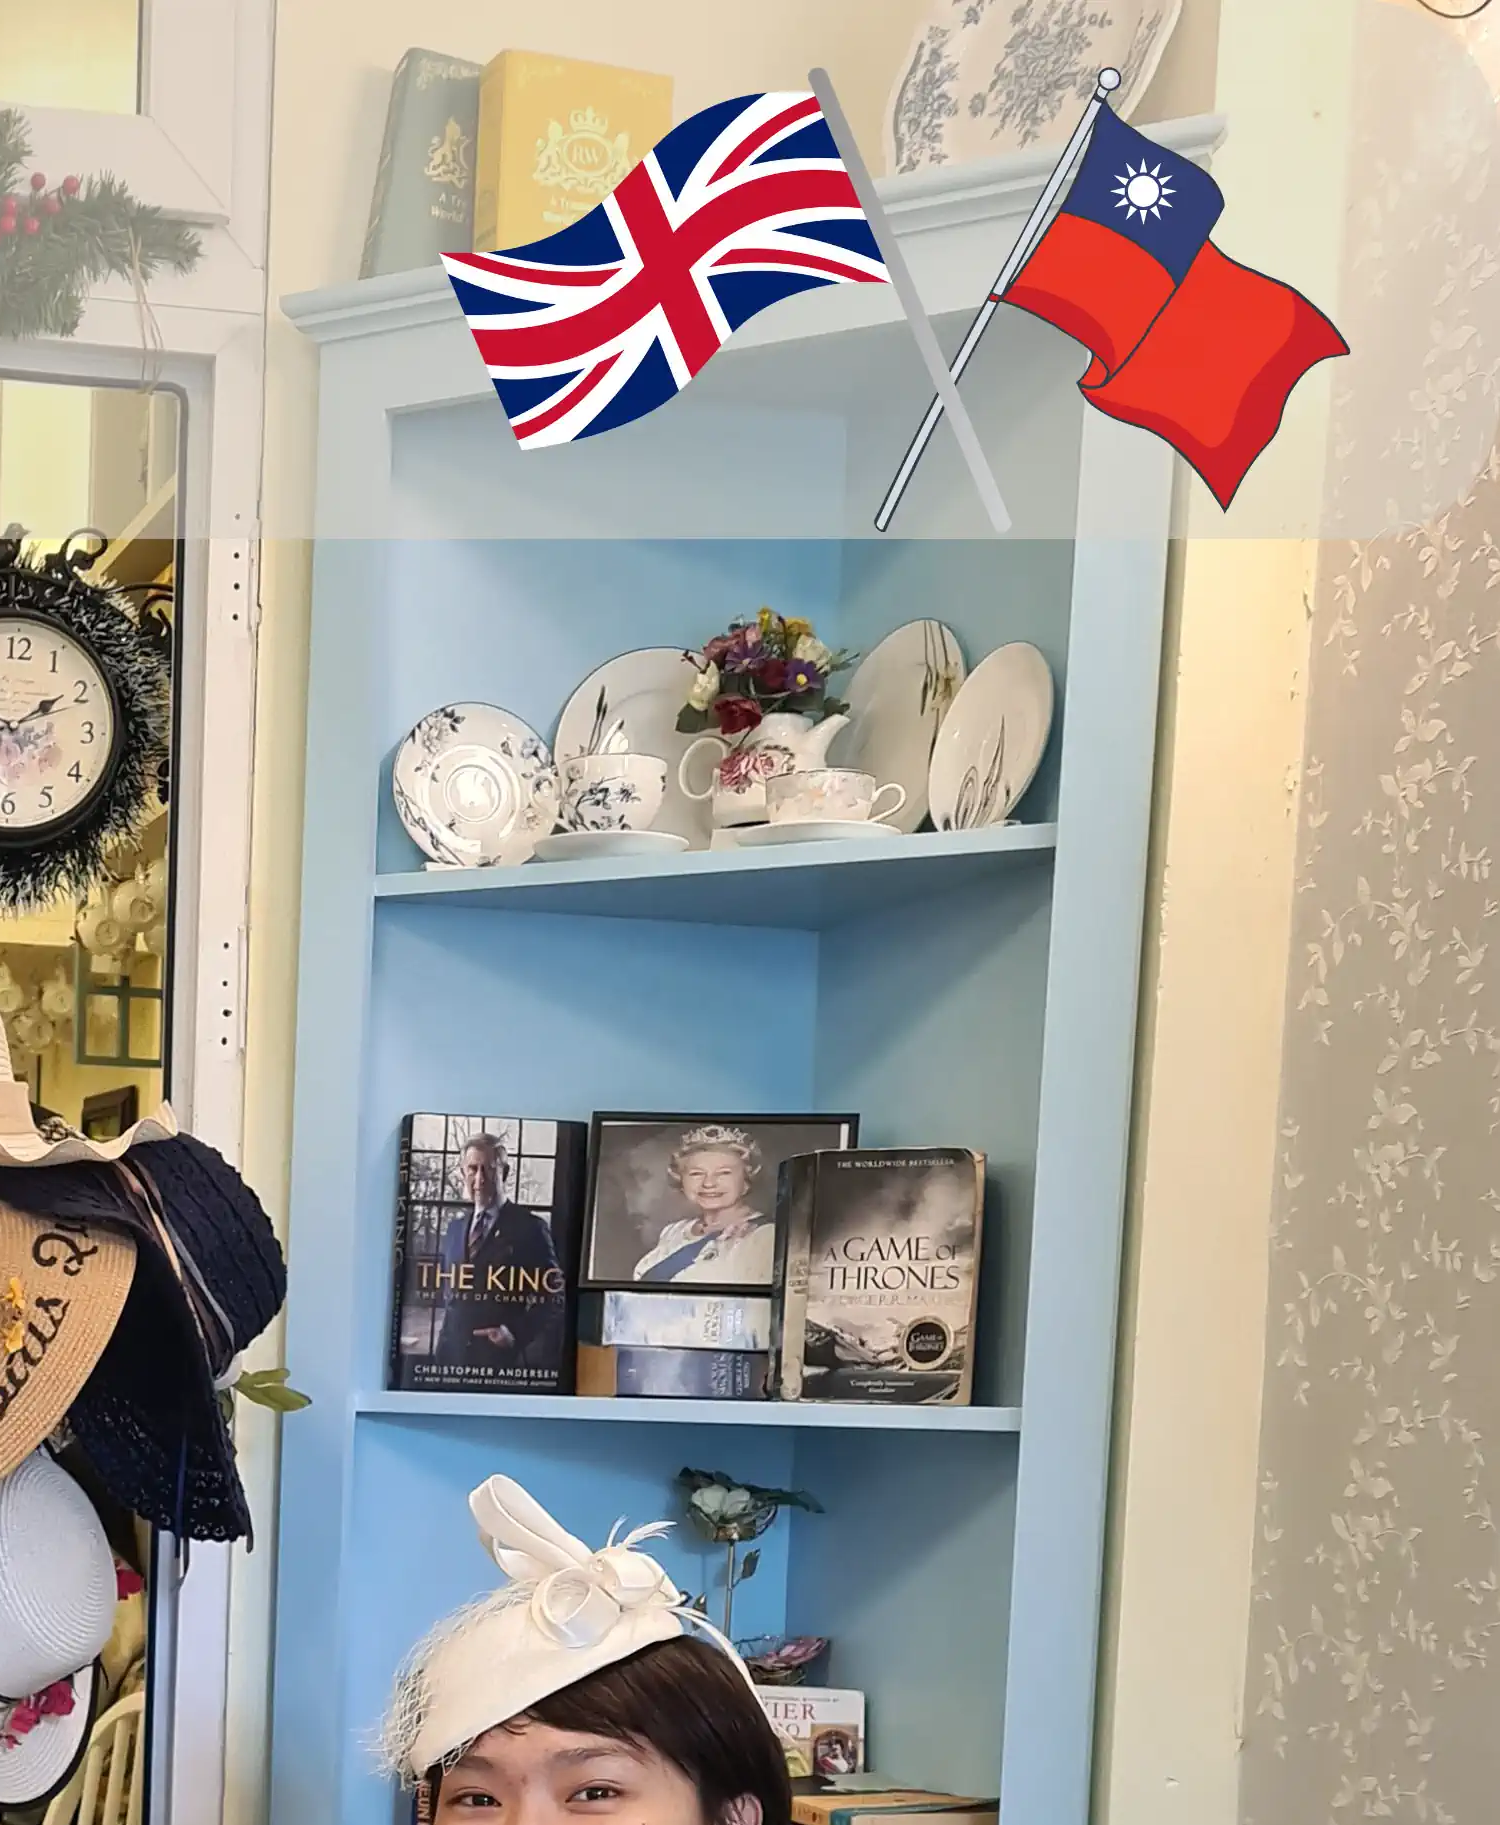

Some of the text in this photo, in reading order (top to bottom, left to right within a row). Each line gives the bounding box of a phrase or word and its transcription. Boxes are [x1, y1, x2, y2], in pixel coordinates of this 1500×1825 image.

[6, 636, 32, 661] 12
[49, 650, 59, 673] 1
[73, 680, 89, 704] 2
[80, 721, 95, 745] 3
[67, 761, 83, 783] 4
[1, 791, 16, 815] 6
[38, 786, 54, 809] 5
[837, 1158, 956, 1168] THE WORLDWIDE BESTSELLER
[824, 1236, 961, 1262] A GAME OF
[417, 1262, 566, 1293] THE KING
[823, 1265, 961, 1290] THRONES
[414, 1364, 559, 1379] CHRISTOPHER ANDERSEN
